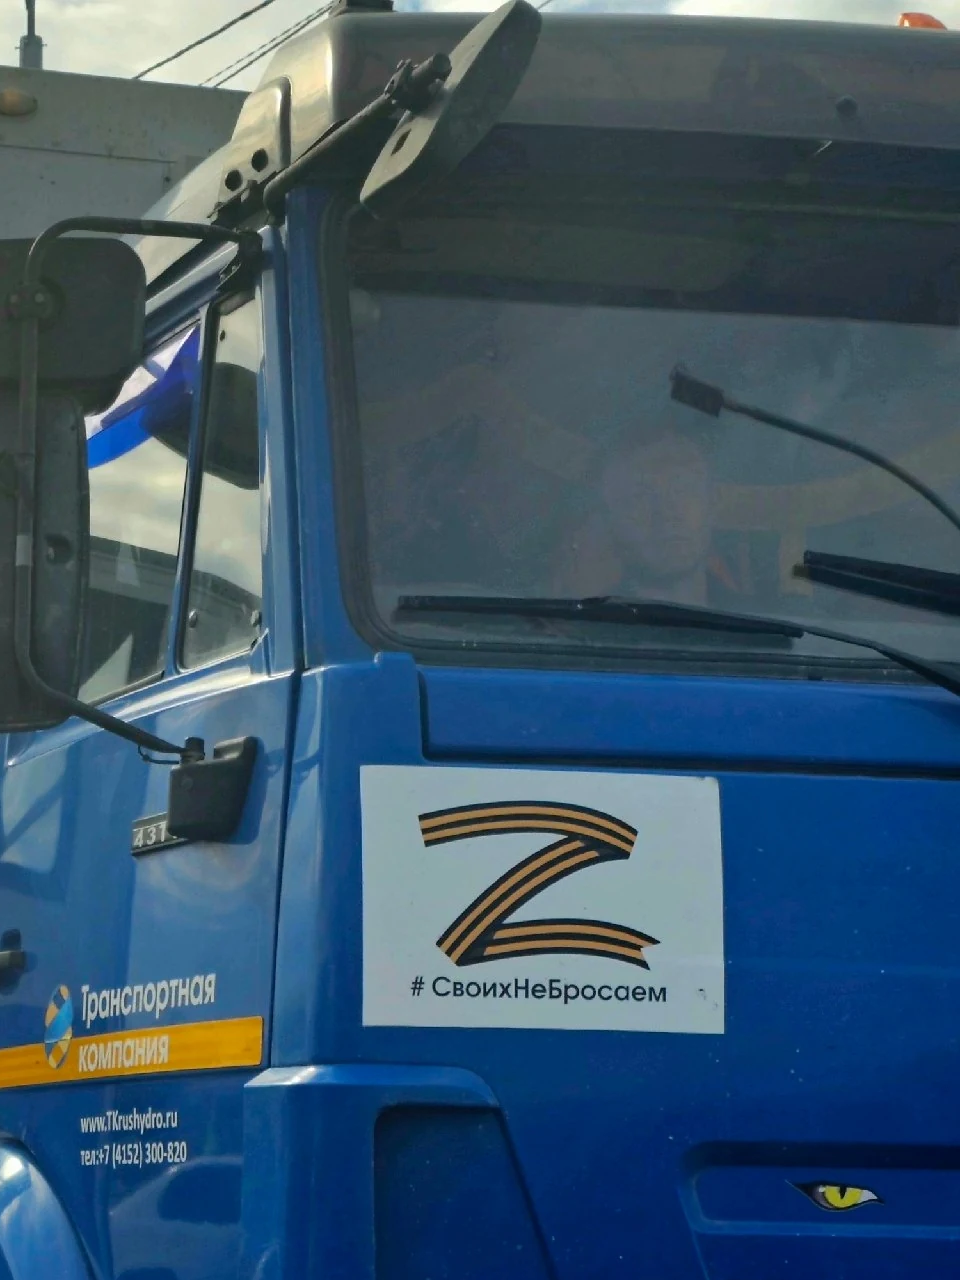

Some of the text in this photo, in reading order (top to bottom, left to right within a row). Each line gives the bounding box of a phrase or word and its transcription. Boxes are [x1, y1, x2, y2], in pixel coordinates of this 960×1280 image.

[133, 820, 175, 848] 431
[418, 800, 661, 971] Z
[81, 973, 216, 1029] Транспортная
[78, 1034, 169, 1073] компания
[80, 1107, 178, 1135] www.TKrushydro.ru
[112, 1142, 143, 1169] (4152)
[145, 1141, 187, 1165] 300-820
